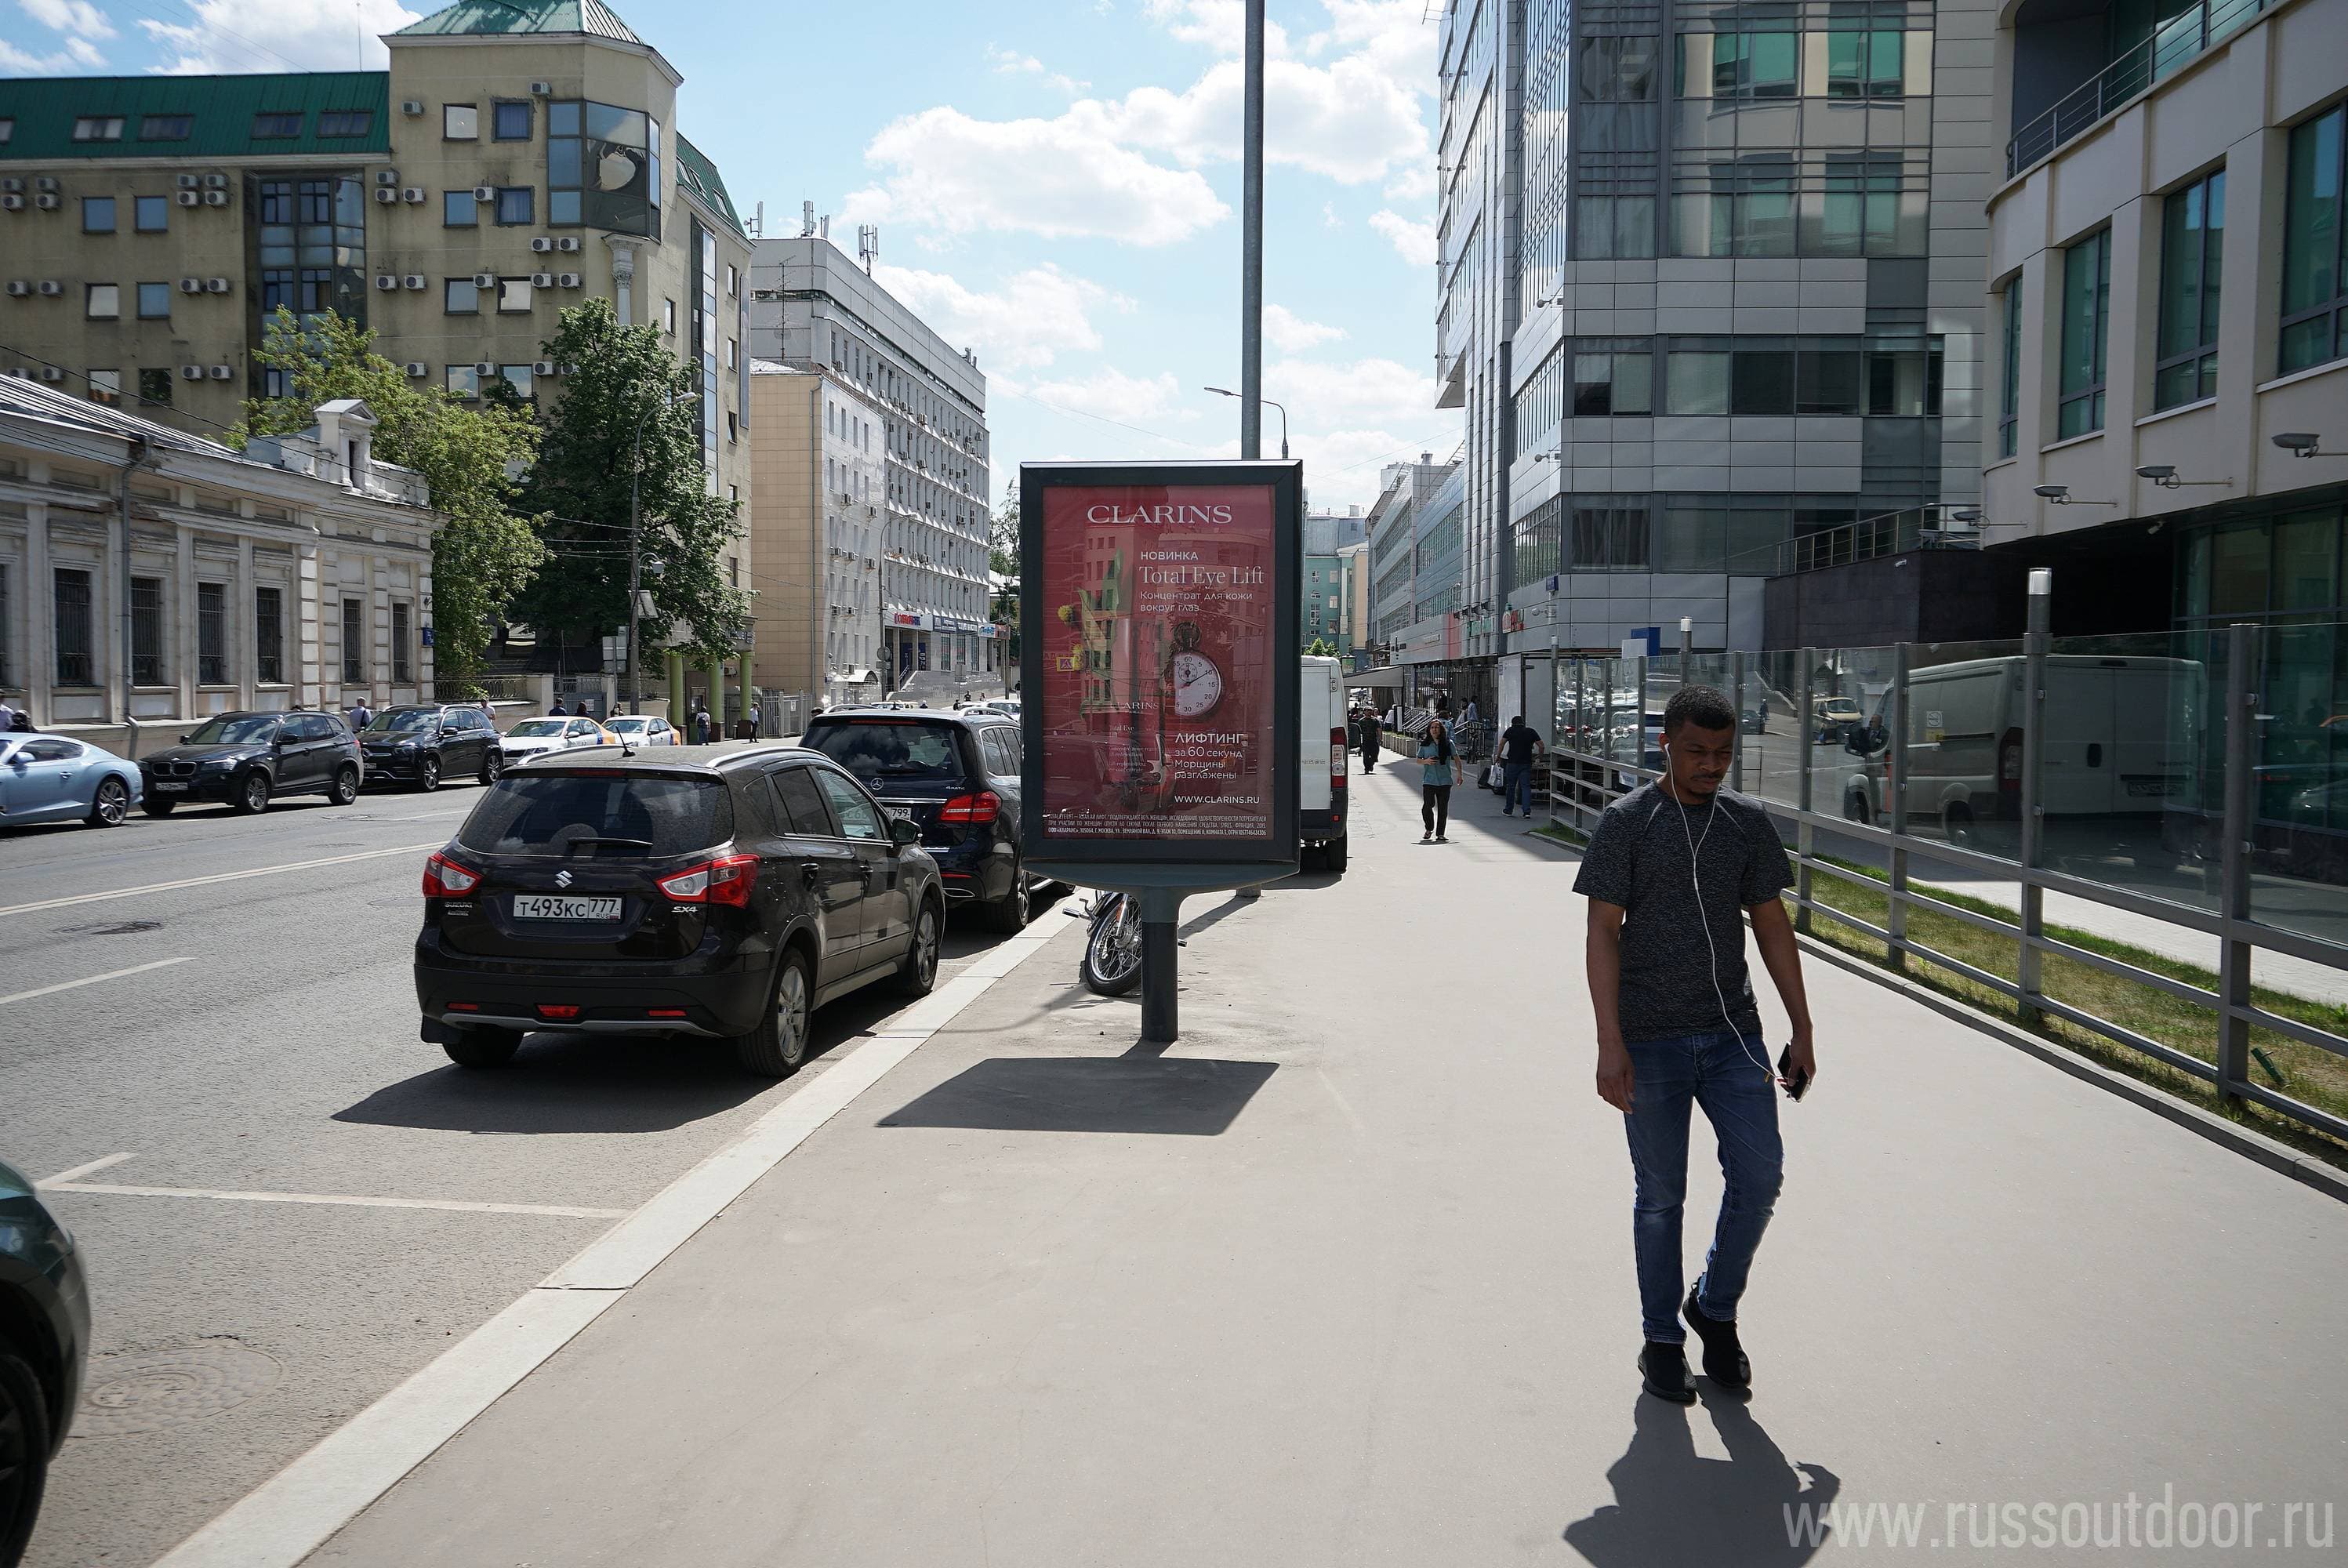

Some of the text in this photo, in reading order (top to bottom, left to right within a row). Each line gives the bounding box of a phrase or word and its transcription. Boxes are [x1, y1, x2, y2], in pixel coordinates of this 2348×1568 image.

[1087, 505, 1232, 524] CLARINS
[1141, 551, 1199, 561] НОВИНКА
[1139, 566, 1265, 589] Total Eye Lift
[1140, 591, 1201, 602] Концентрат
[1140, 604, 1175, 613] вокруг
[1175, 733, 1244, 743] ЛИФТИНГ
[1188, 746, 1205, 757] 60
[1174, 760, 1226, 769] Морщины
[891, 808, 908, 817] 799
[520, 899, 617, 917] Т493КС 777
